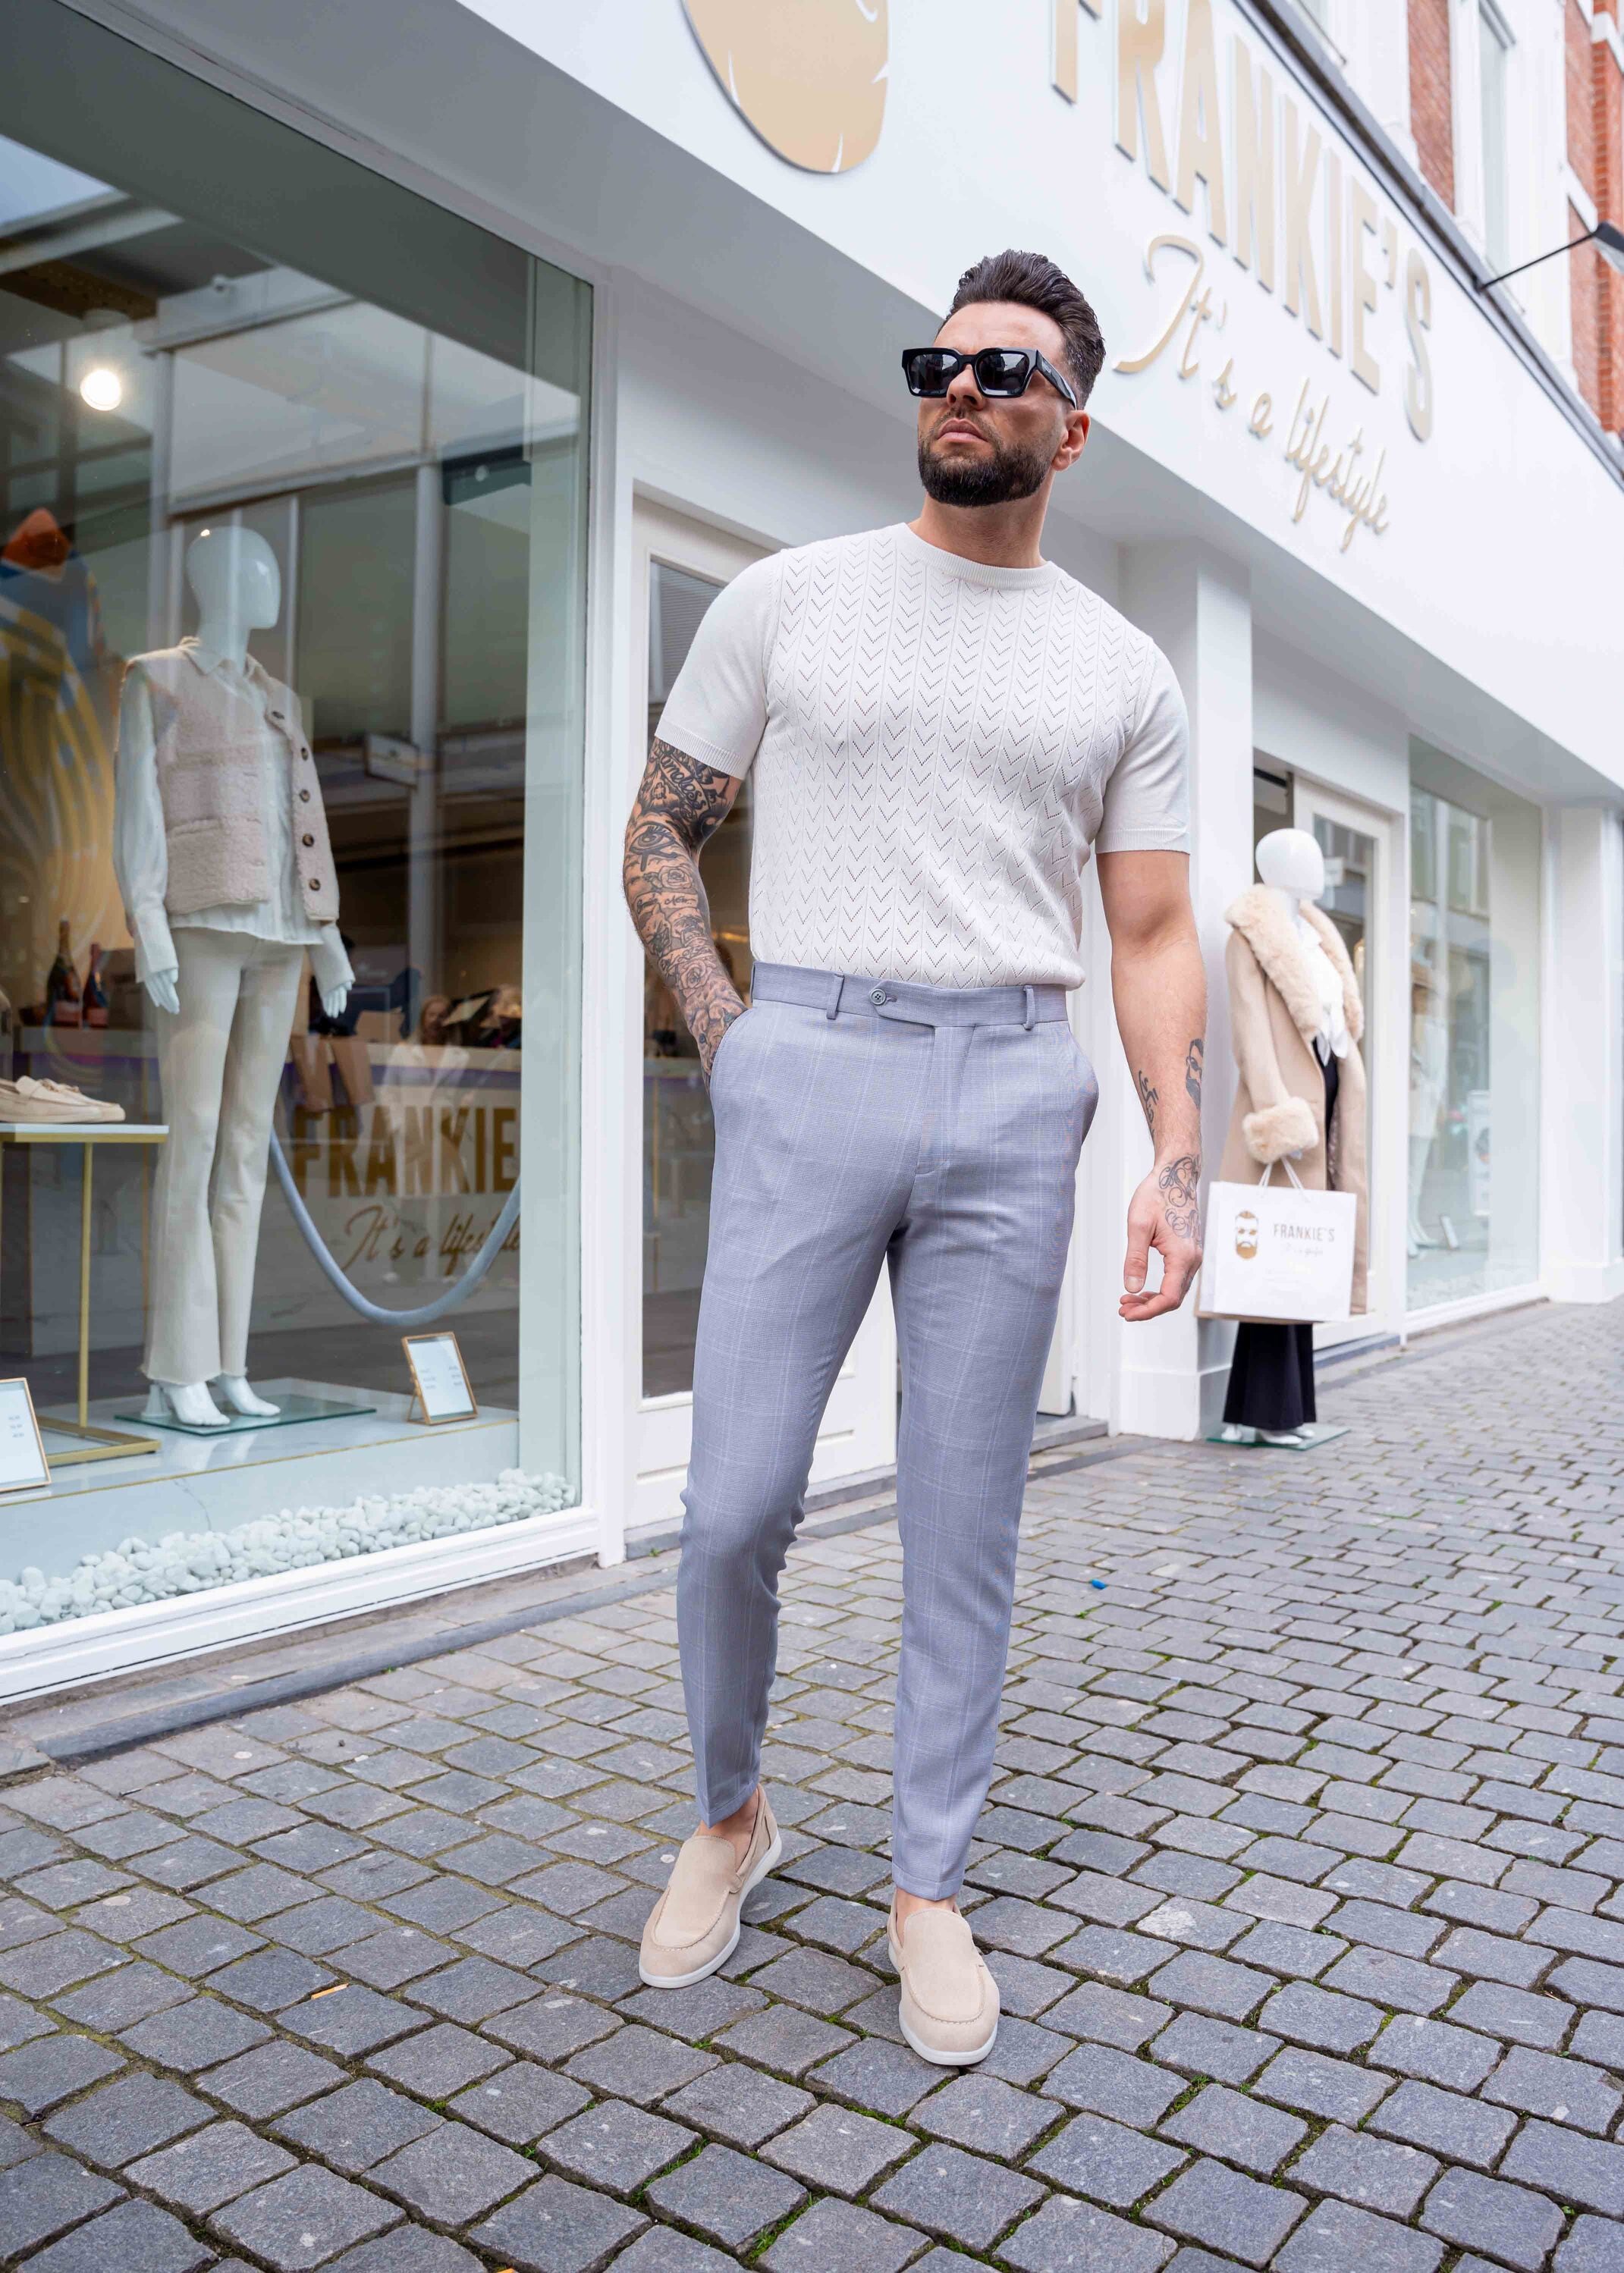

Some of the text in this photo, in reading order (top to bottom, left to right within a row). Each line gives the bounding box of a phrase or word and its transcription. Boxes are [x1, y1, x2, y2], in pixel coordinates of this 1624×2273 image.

[1113, 234, 1390, 553] It's a lifestyle
[1273, 1223, 1335, 1242] FRANKIE'S
[413, 1236, 430, 1258] a
